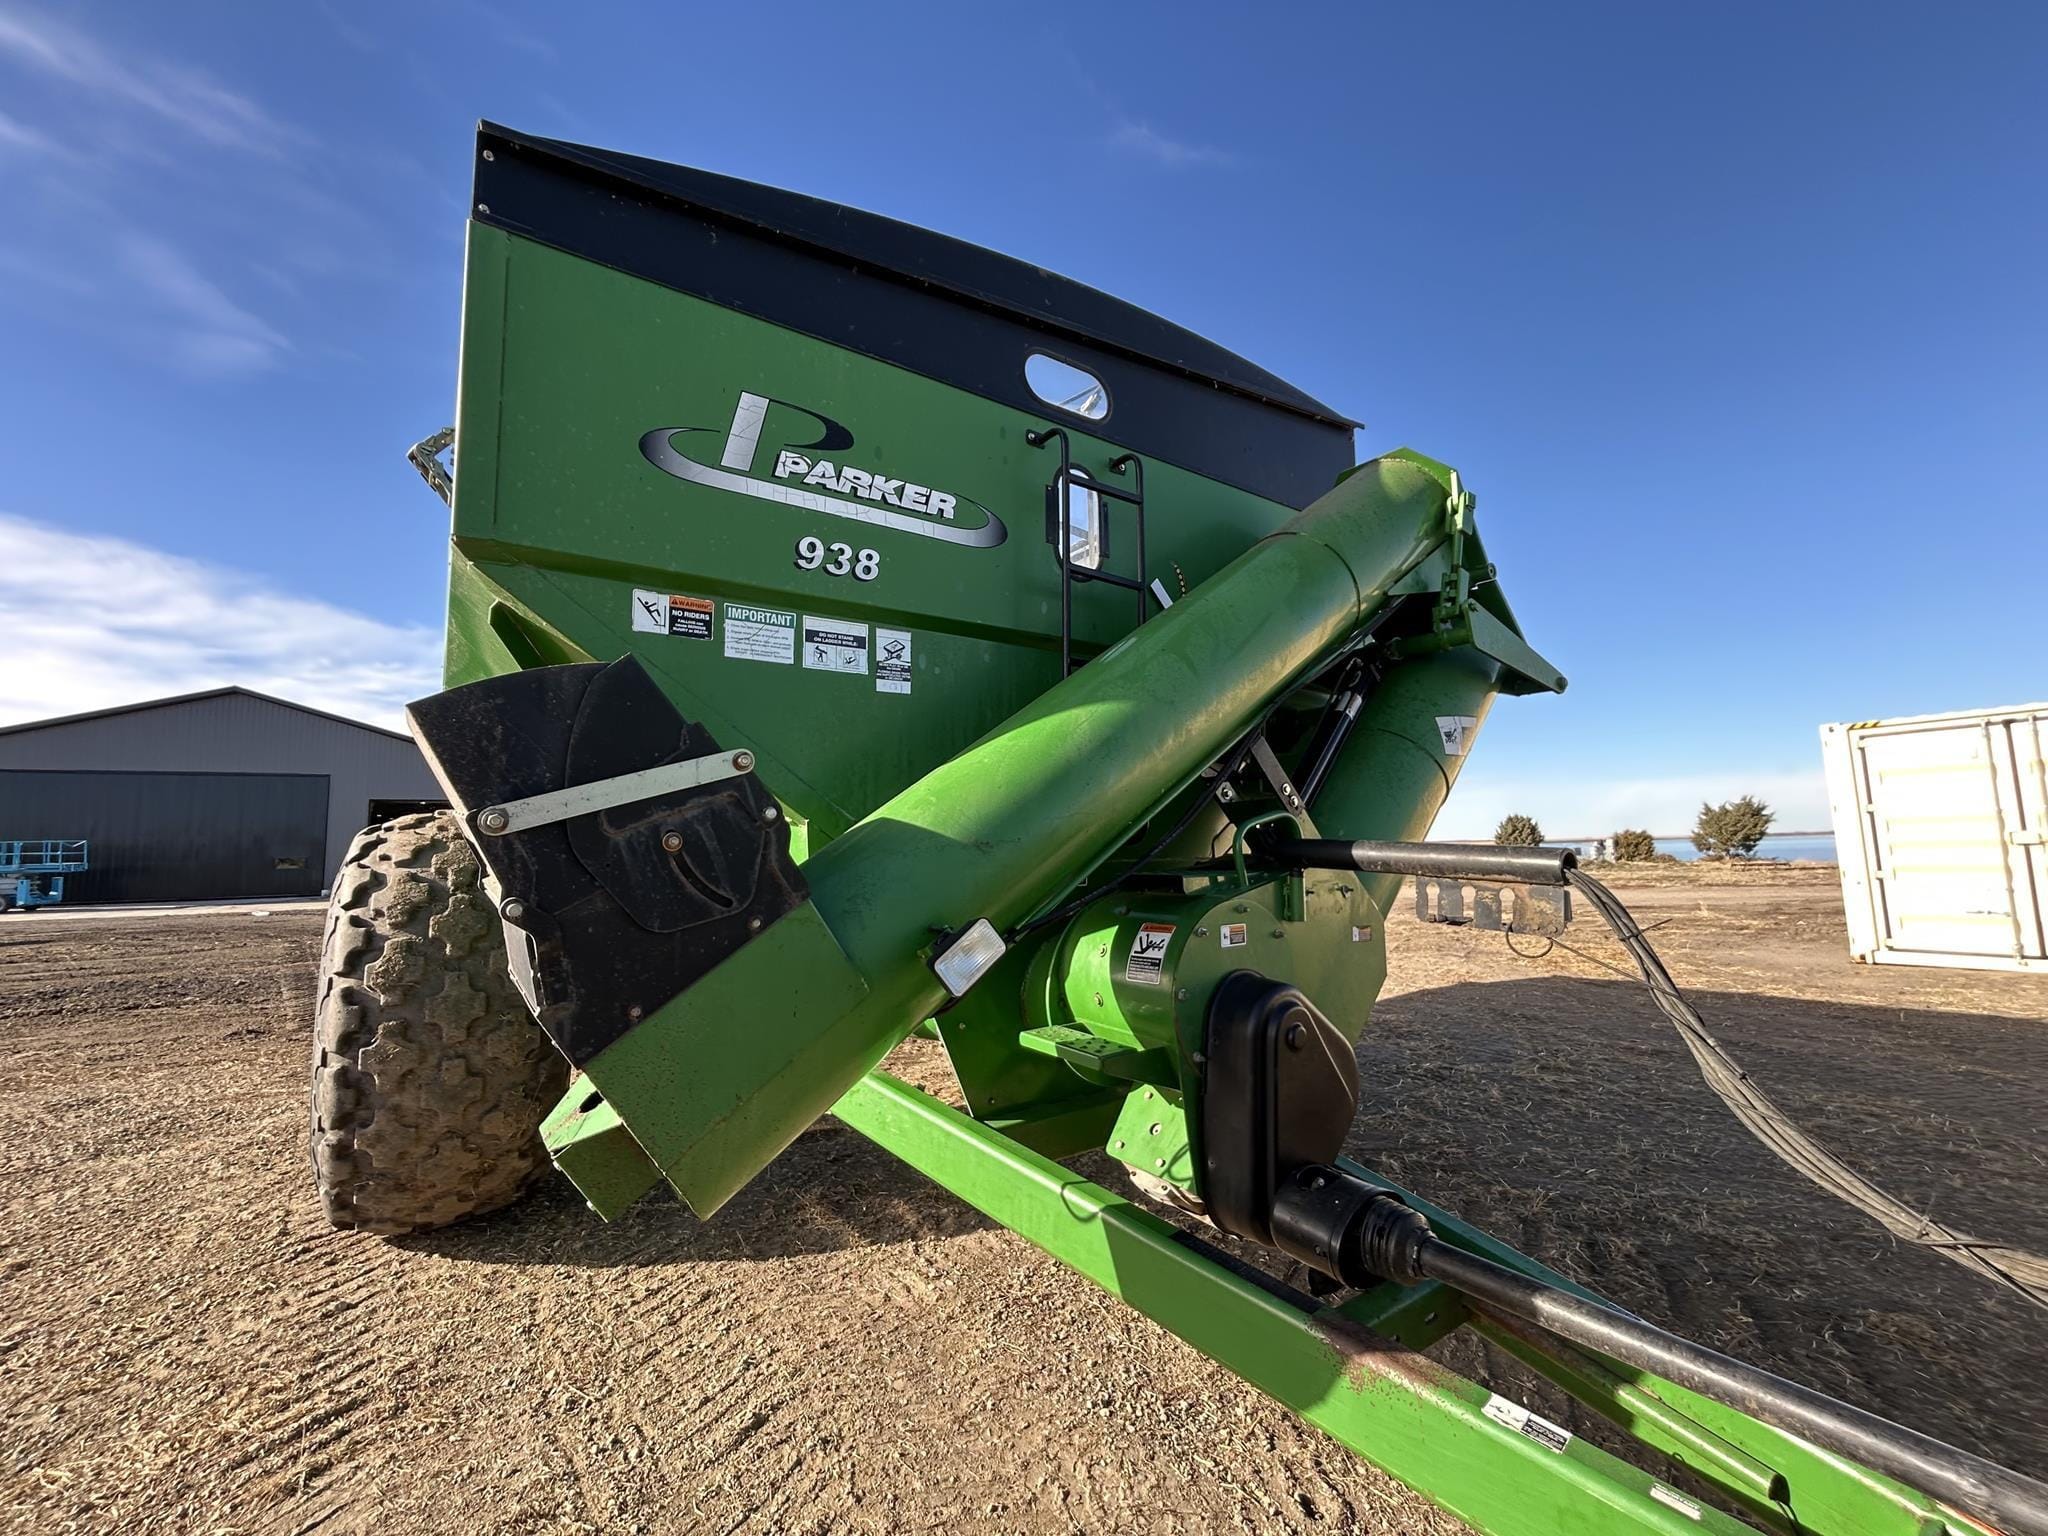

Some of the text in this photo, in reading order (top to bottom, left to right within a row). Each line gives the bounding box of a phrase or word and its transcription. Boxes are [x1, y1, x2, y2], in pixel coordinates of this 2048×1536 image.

[774, 450, 957, 519] PARKER
[796, 537, 880, 581] 938
[672, 609, 710, 621] NO RIDERS
[678, 599, 712, 611] WARNING
[727, 606, 792, 626] IMPORTANT
